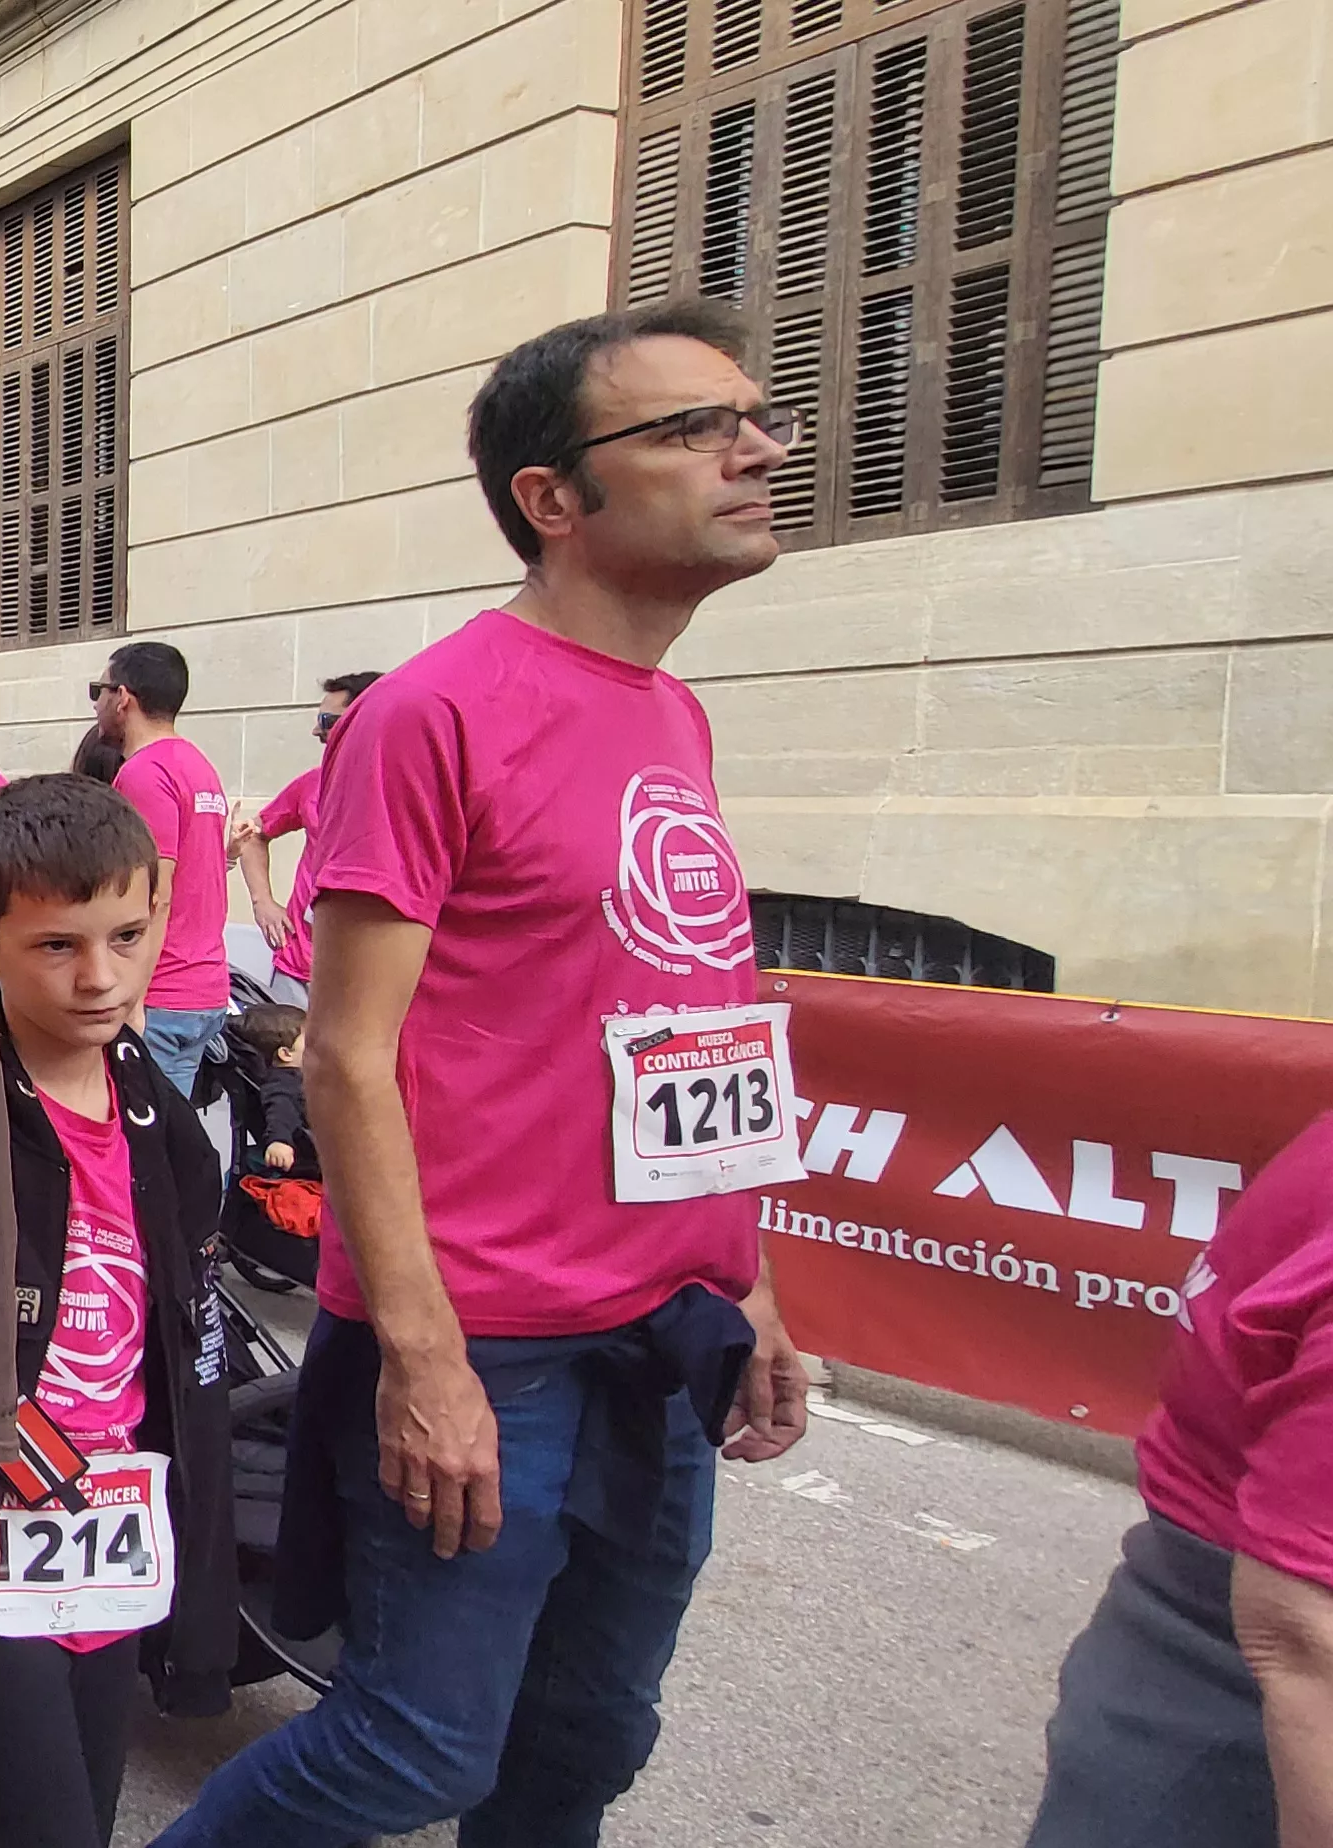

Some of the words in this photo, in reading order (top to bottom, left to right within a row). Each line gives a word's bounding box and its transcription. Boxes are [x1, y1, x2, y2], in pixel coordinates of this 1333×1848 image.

[643, 1050, 712, 1073] CONTRA
[712, 1049, 726, 1064] EL
[727, 1040, 766, 1061] CÁNCER
[697, 1032, 734, 1048] HUESCA
[645, 1067, 774, 1147] 1213
[757, 1196, 1061, 1294] limentación
